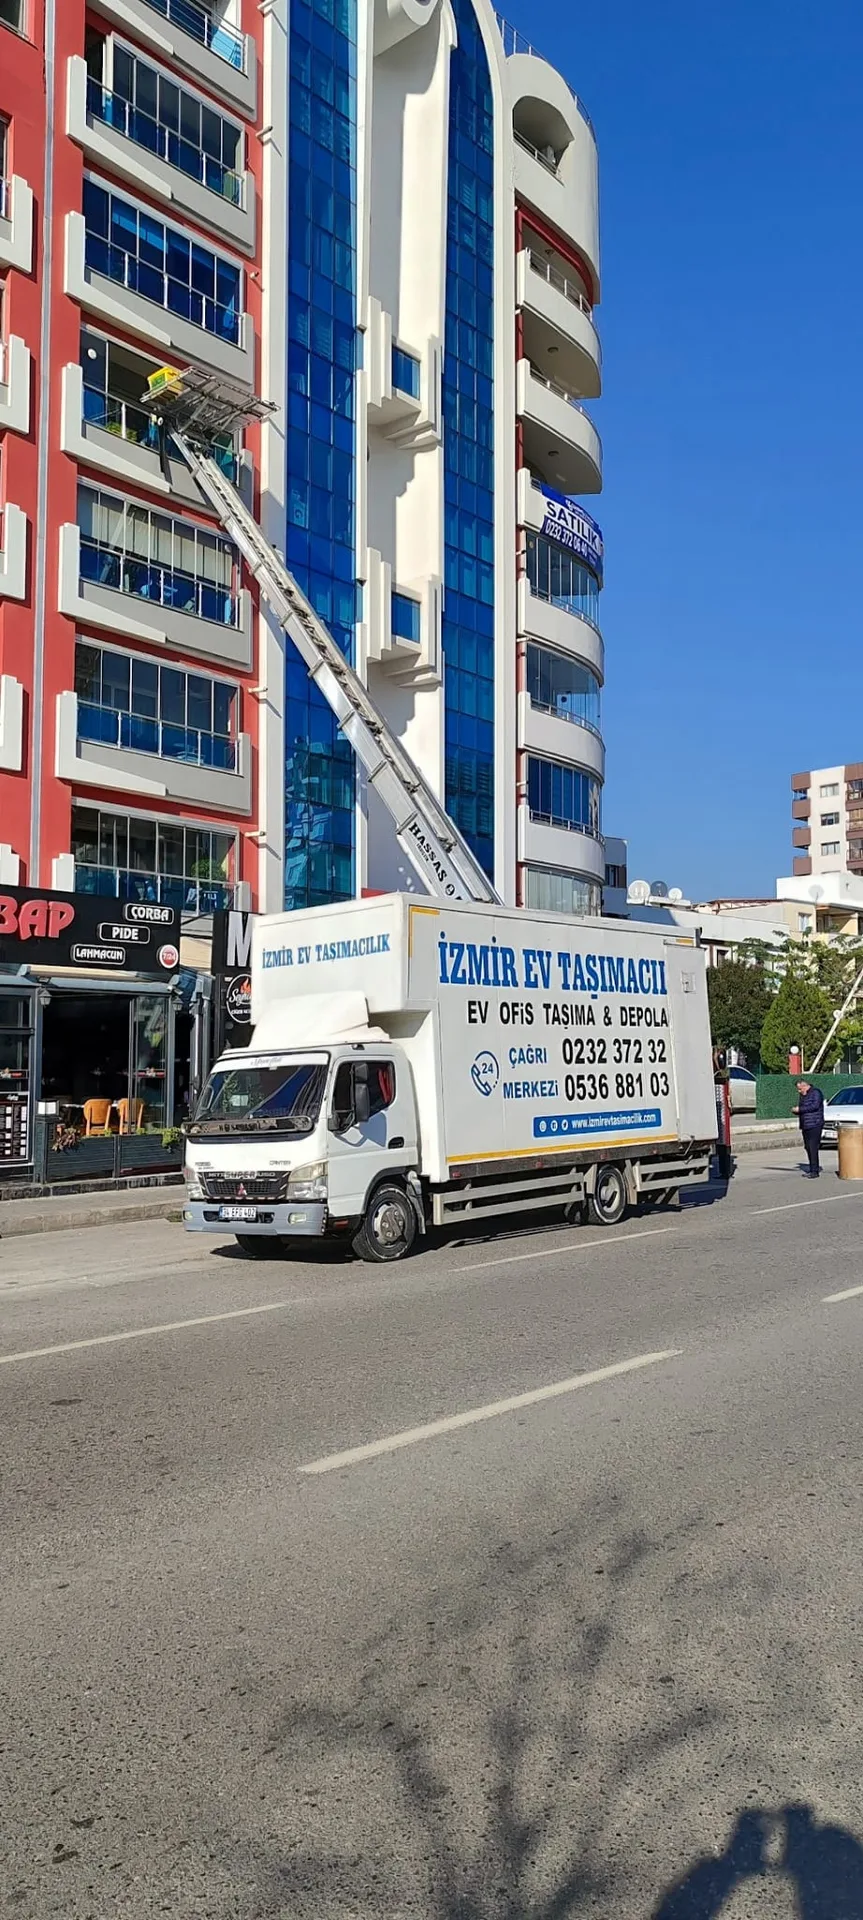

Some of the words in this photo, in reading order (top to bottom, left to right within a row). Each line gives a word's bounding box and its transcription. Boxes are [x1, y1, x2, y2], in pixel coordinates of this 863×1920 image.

[545, 519, 562, 541] 0232
[561, 529, 574, 547] 372
[546, 501, 600, 550] SATILIK
[408, 821, 448, 883] HASSAS
[130, 906, 170, 922] ÇORBA
[75, 948, 123, 961] LAHMACUN
[262, 945, 293, 969] İZMİR
[297, 945, 312, 965] EV
[315, 933, 390, 964] TAŞIMACILIK
[438, 931, 518, 987] İZMİR
[522, 949, 552, 988] EV
[467, 1000, 489, 1024] EV
[543, 1003, 596, 1029] TAŞIMA
[603, 1005, 613, 1027] &
[620, 1006, 668, 1027] DEPOLA
[509, 1044, 547, 1069] ÇAĞRI
[562, 1038, 607, 1065] 0232
[613, 1039, 643, 1064] 372
[648, 1039, 667, 1063] 32
[482, 1062, 494, 1074] 24
[564, 1073, 609, 1101] 0536
[615, 1073, 644, 1098] 881
[650, 1072, 670, 1097] 03
[571, 1113, 656, 1129] www.izmirevtasimacilik.com
